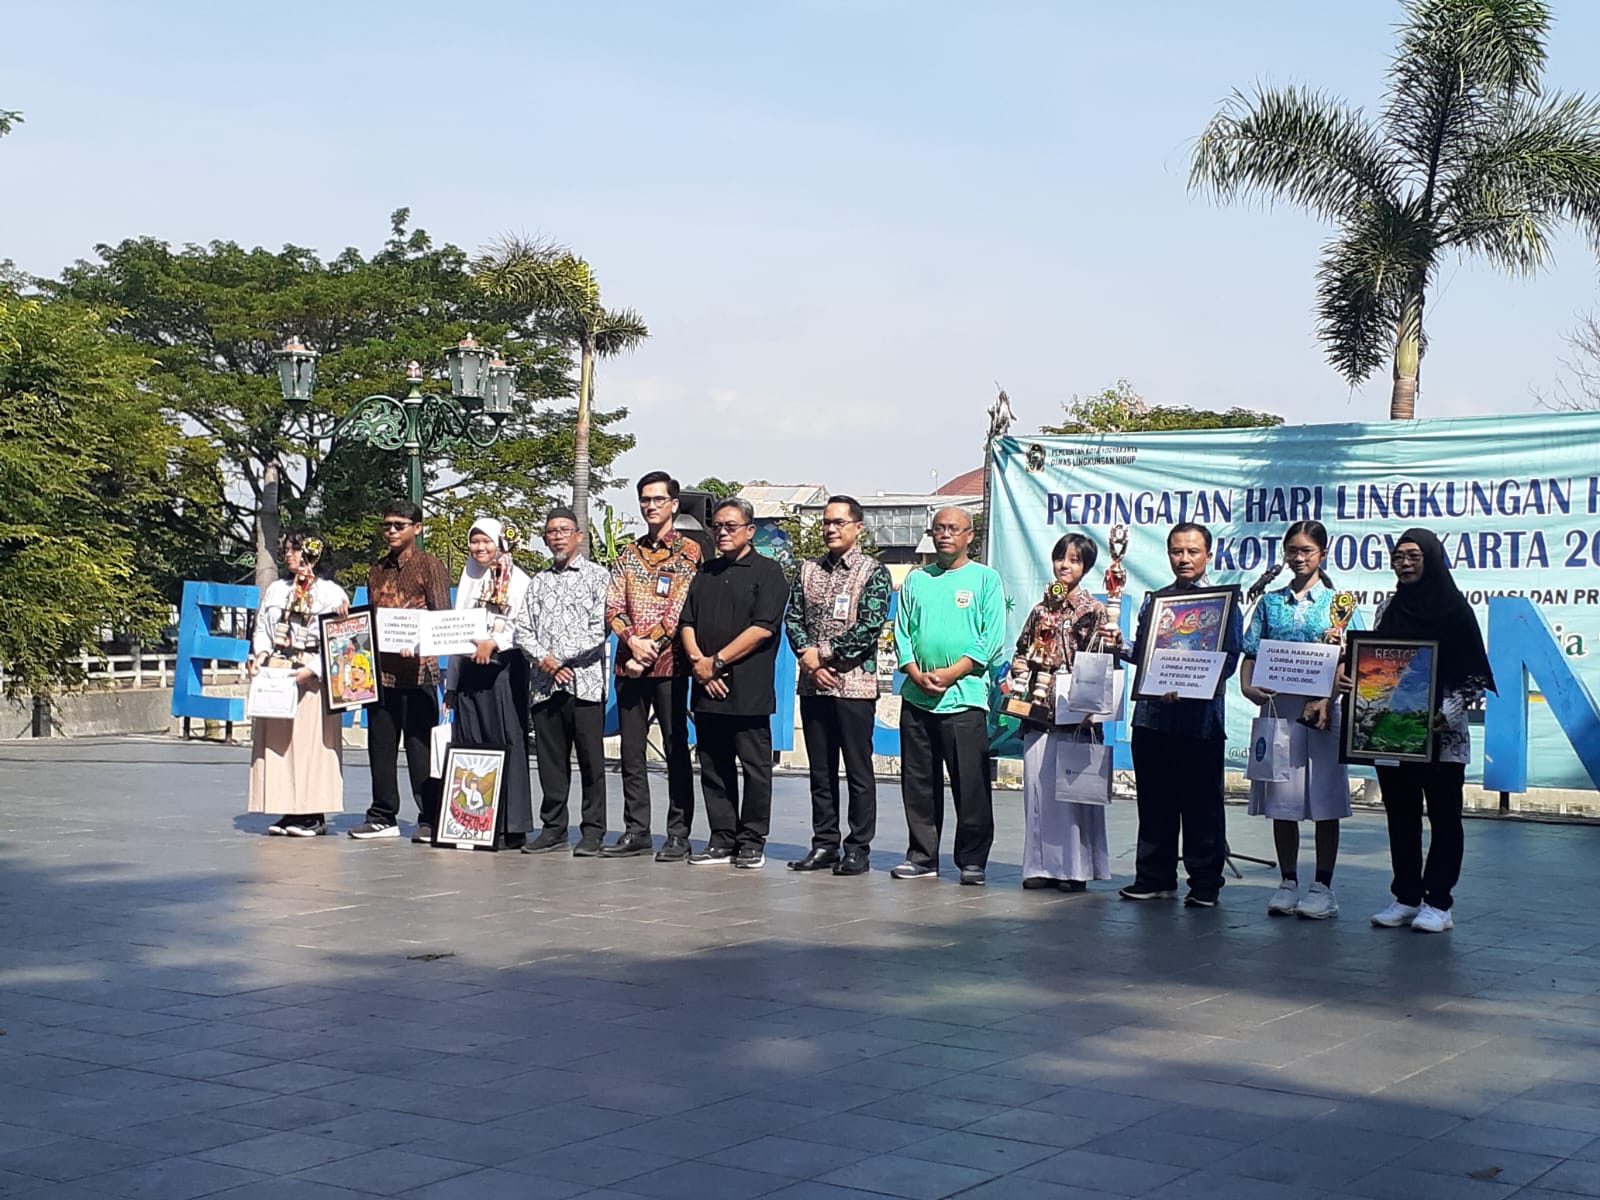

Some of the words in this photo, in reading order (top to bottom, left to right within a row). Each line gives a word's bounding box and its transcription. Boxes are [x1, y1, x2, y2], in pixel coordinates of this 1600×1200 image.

[1051, 458, 1071, 466] DINAS
[1073, 457, 1114, 467] LINGKUNGAN
[1115, 455, 1137, 465] HIDUP
[1047, 489, 1232, 525] PERINGATAN
[1245, 486, 1324, 522] HARI
[1337, 477, 1572, 520] LINGKUNGAN
[1215, 536, 1283, 571] KOT
[1530, 588, 1567, 605] DAN
[1160, 671, 1192, 679] KATEGORI
